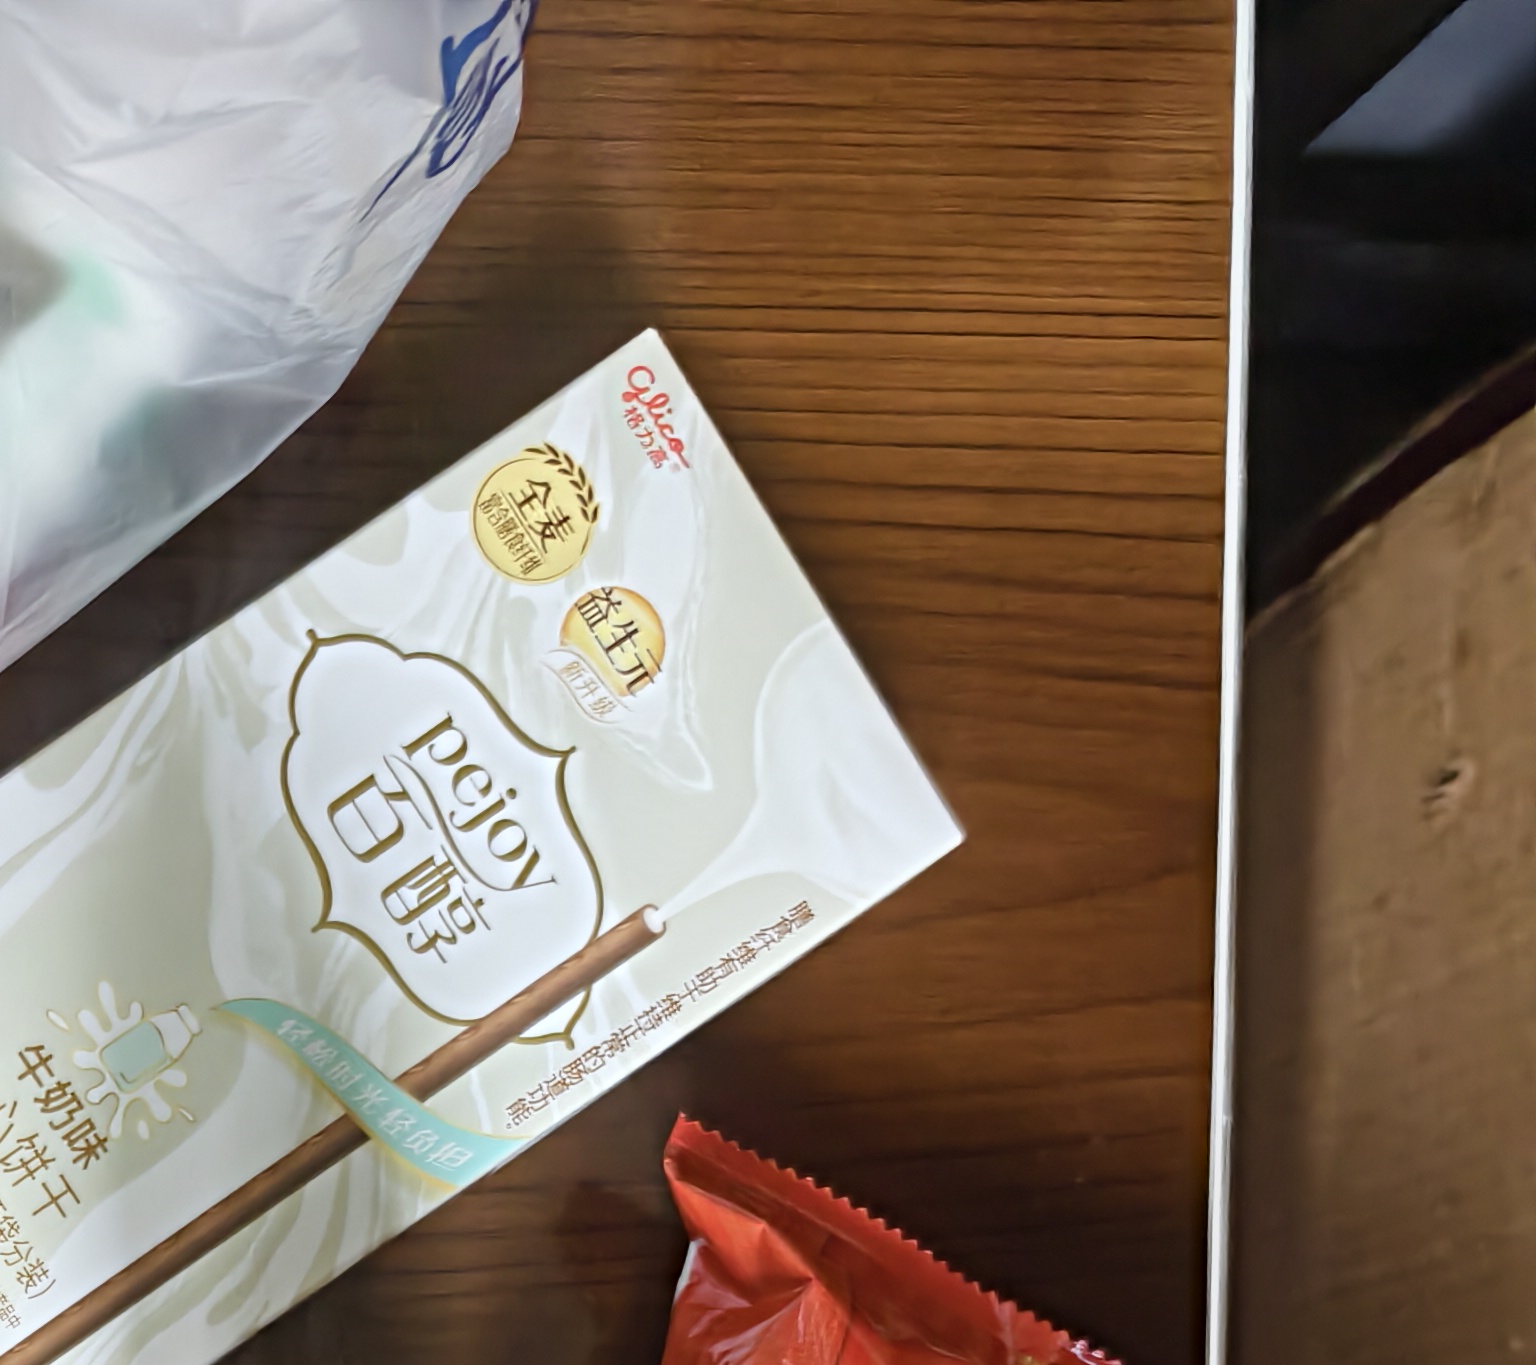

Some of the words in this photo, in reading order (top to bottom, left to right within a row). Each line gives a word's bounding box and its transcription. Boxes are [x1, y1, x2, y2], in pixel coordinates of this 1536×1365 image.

[621, 364, 691, 473] Glico
[622, 405, 664, 471] 格力高
[514, 476, 576, 554] 全麦
[556, 656, 618, 721] 新升级
[574, 586, 666, 698] 益生元
[401, 711, 558, 892] pejoy
[326, 756, 490, 964] 百醇
[16, 1042, 110, 1173] 牛奶味
